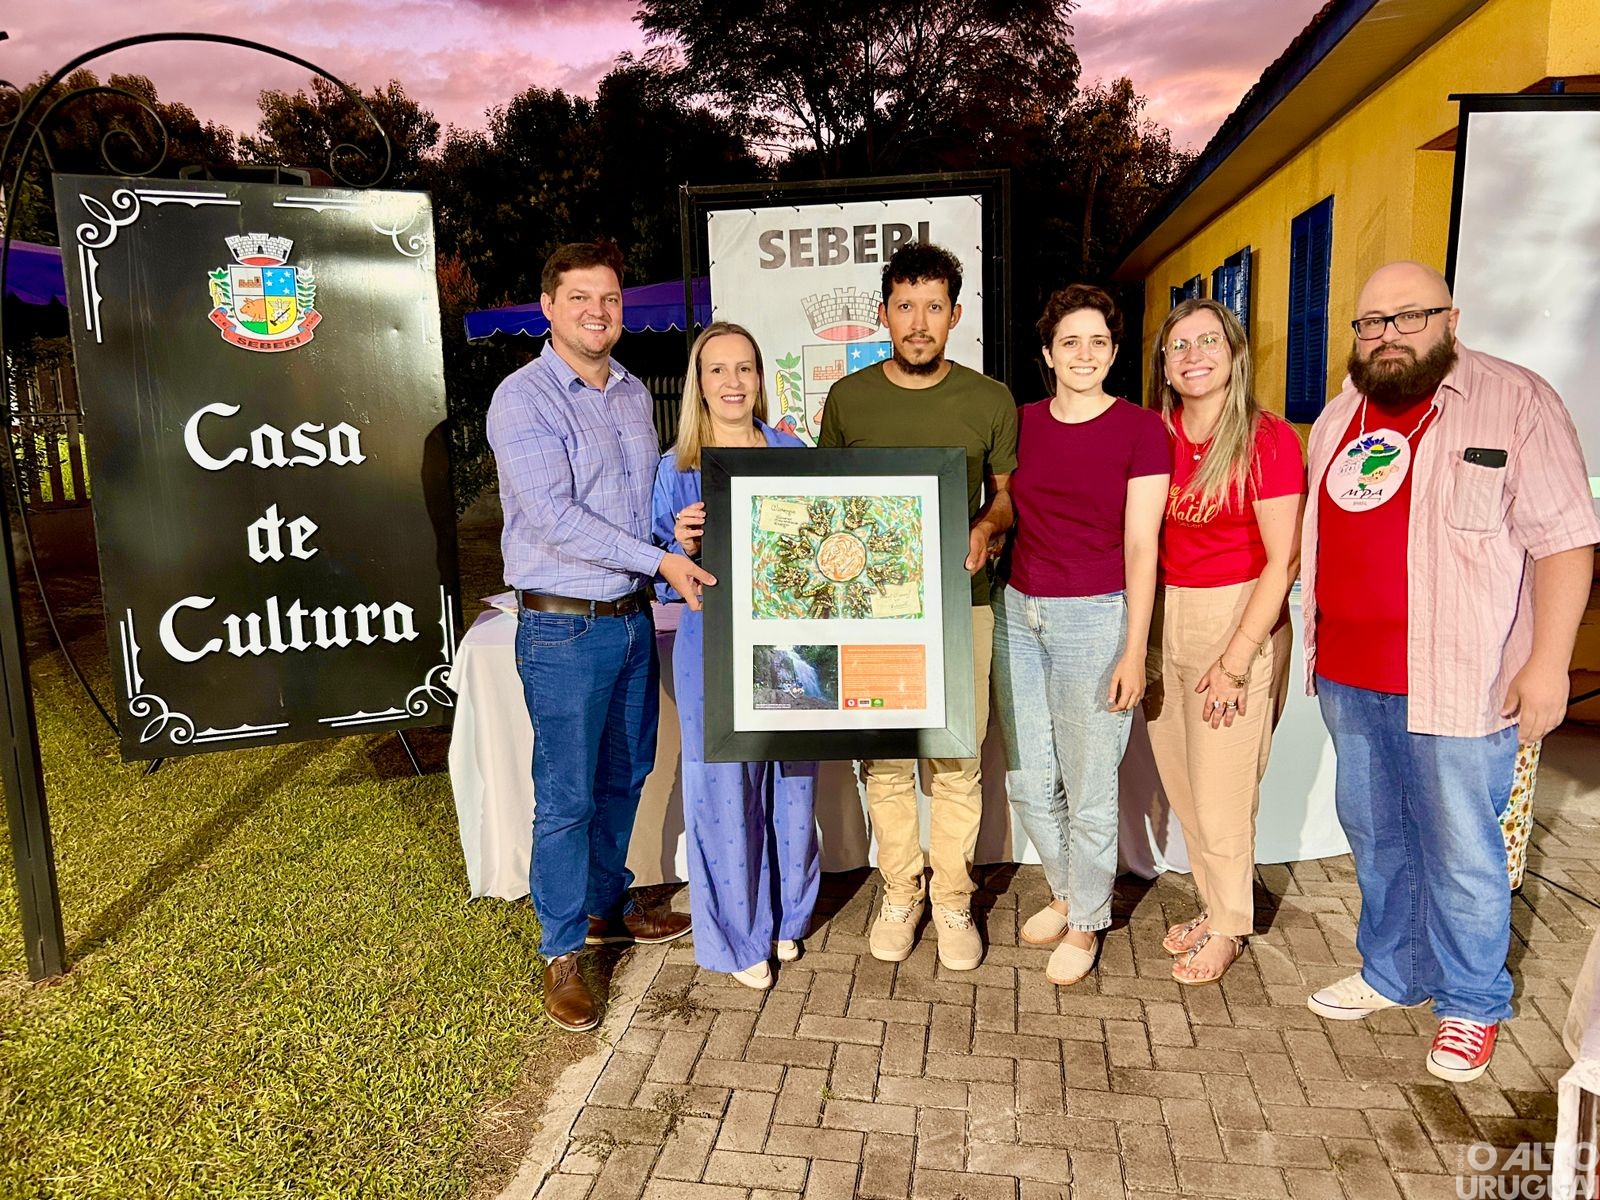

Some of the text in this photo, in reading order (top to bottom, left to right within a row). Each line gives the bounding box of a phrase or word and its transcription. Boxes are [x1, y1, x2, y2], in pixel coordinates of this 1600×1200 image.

[236, 336, 301, 350] SEBERI
[184, 402, 367, 471] Casa
[1166, 493, 1217, 523] Natal
[1340, 488, 1383, 499] MPA
[247, 503, 319, 564] de
[159, 595, 420, 663] Cultura
